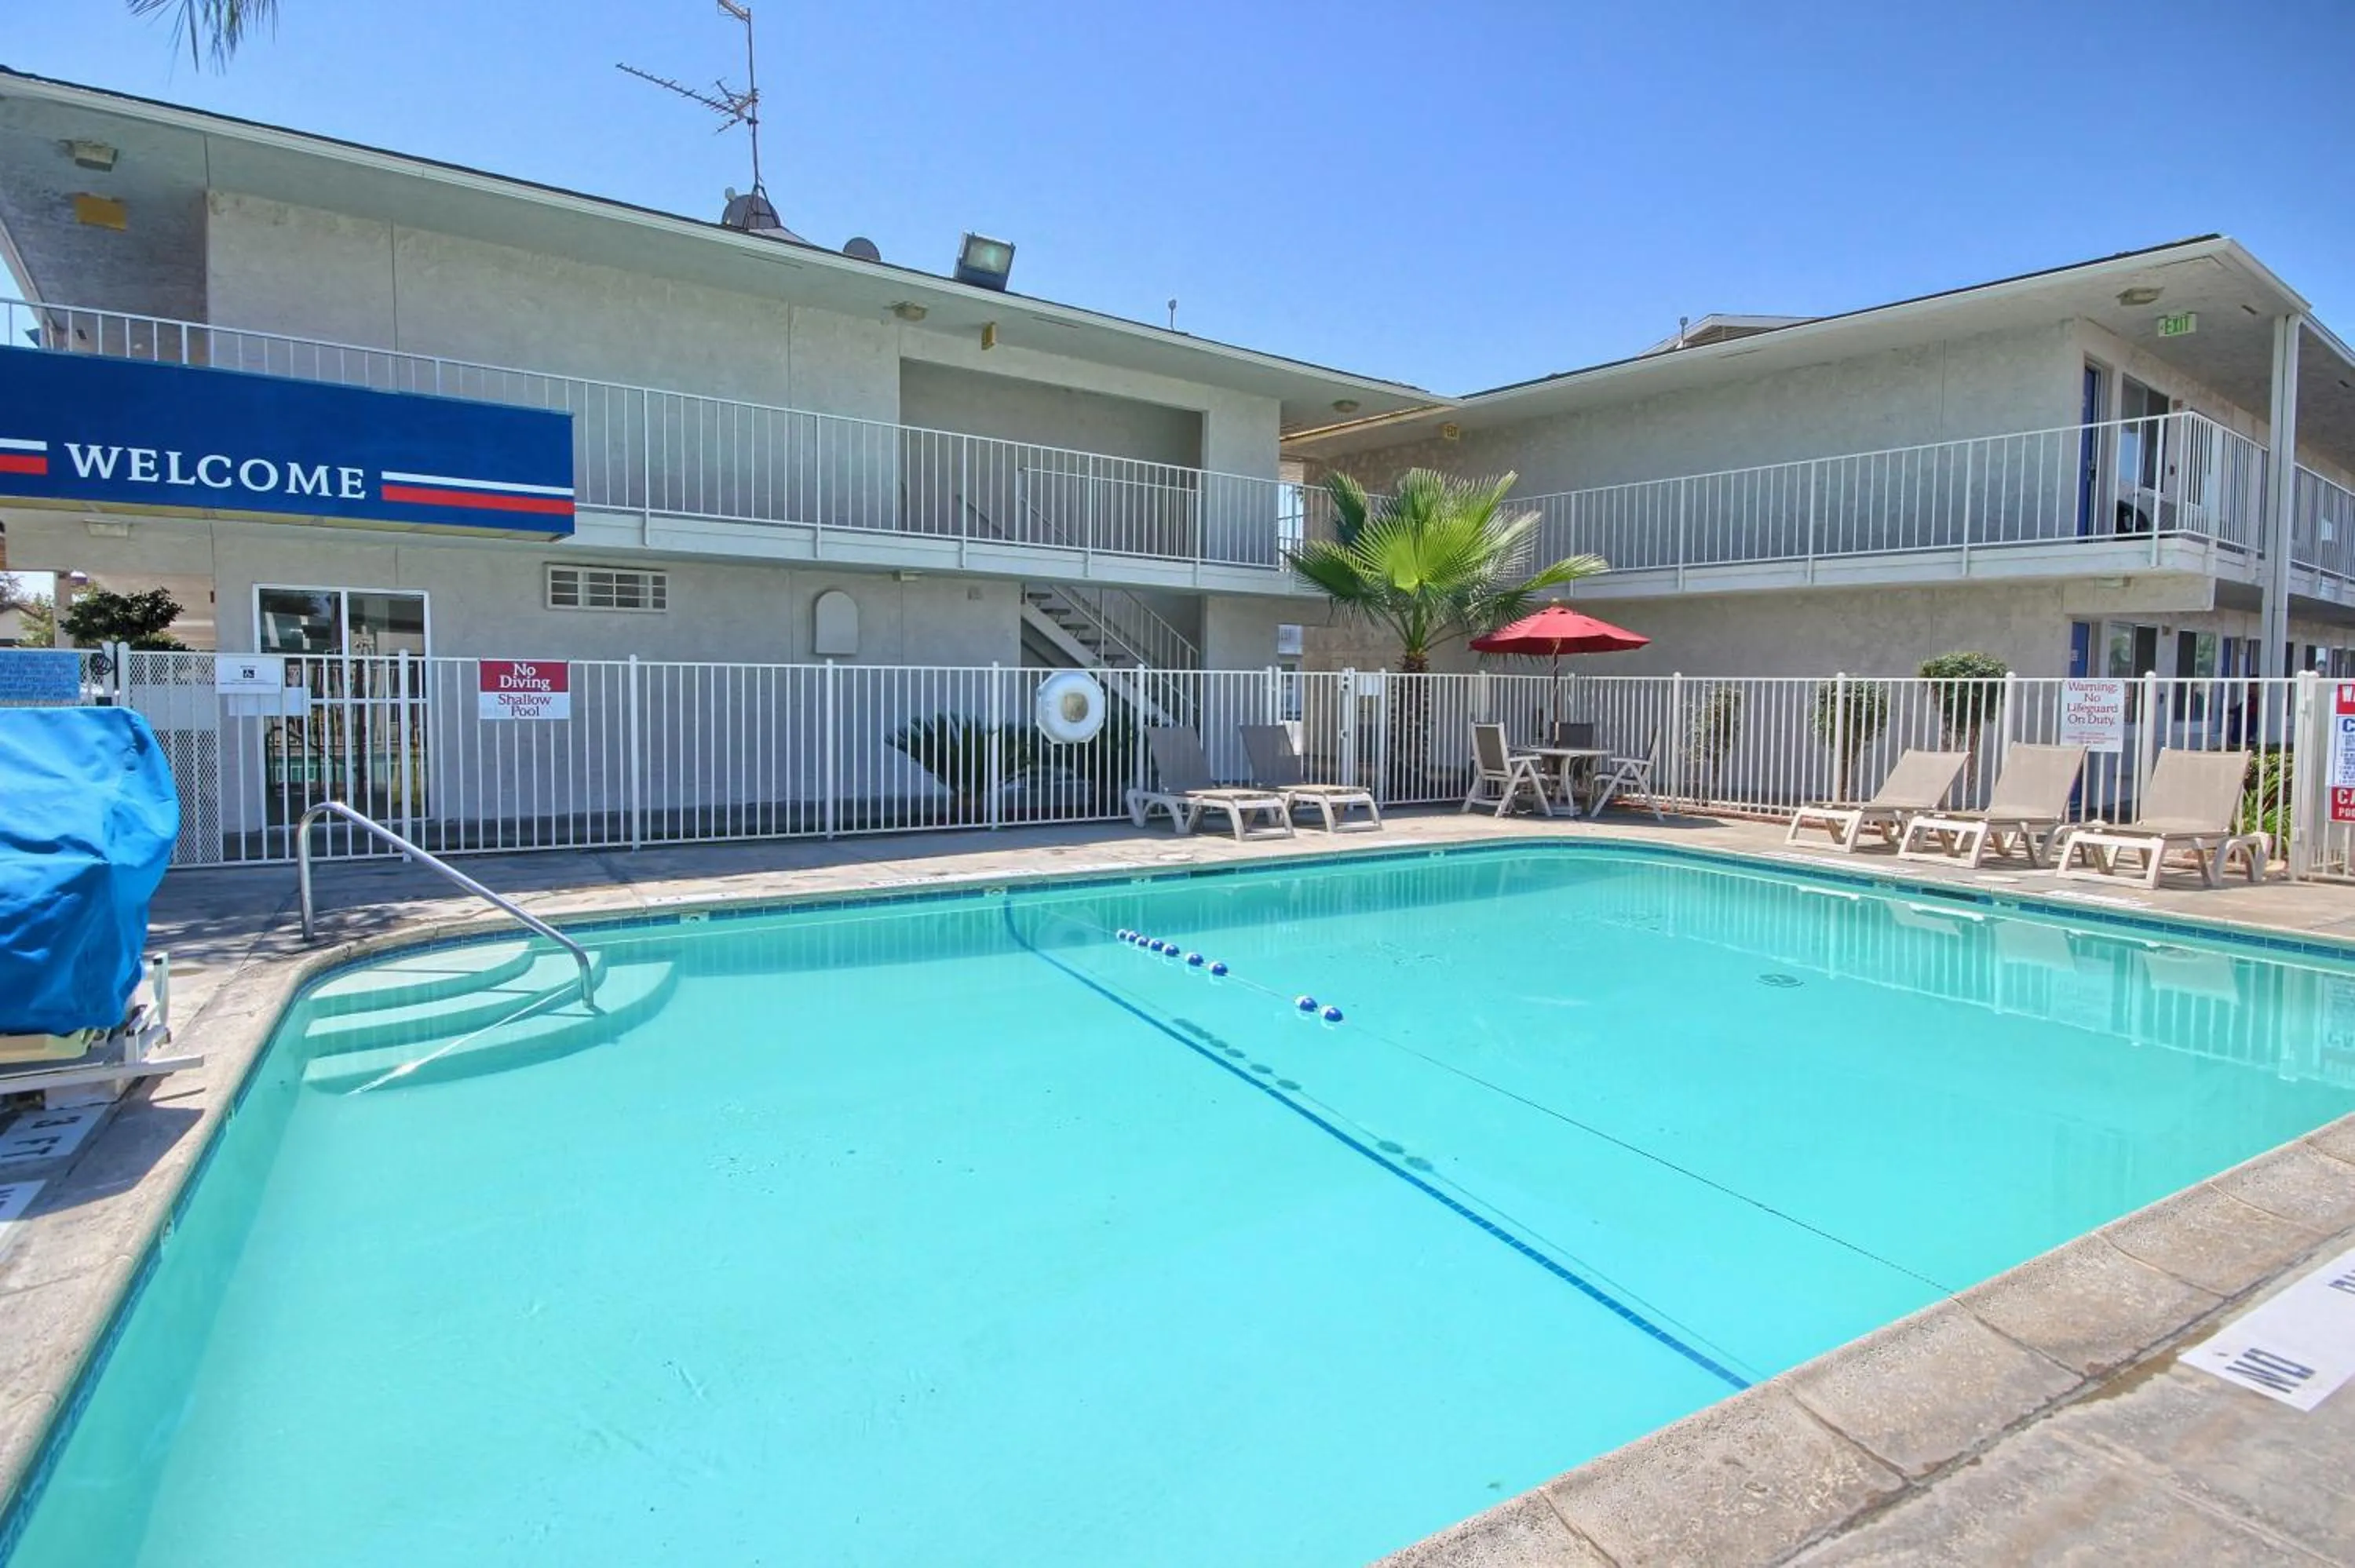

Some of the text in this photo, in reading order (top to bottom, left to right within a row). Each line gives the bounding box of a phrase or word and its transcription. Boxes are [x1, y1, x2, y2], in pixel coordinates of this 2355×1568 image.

[2164, 314, 2190, 335] EXIT
[64, 443, 367, 500] WELCOME
[513, 663, 536, 676] No
[499, 675, 551, 691] Diving
[498, 694, 552, 706] Shallow
[2084, 693, 2101, 702] No
[511, 706, 539, 717] Pool
[2067, 702, 2118, 716] Lifeguard
[2067, 713, 2085, 724] On
[2224, 1347, 2316, 1394] NO
